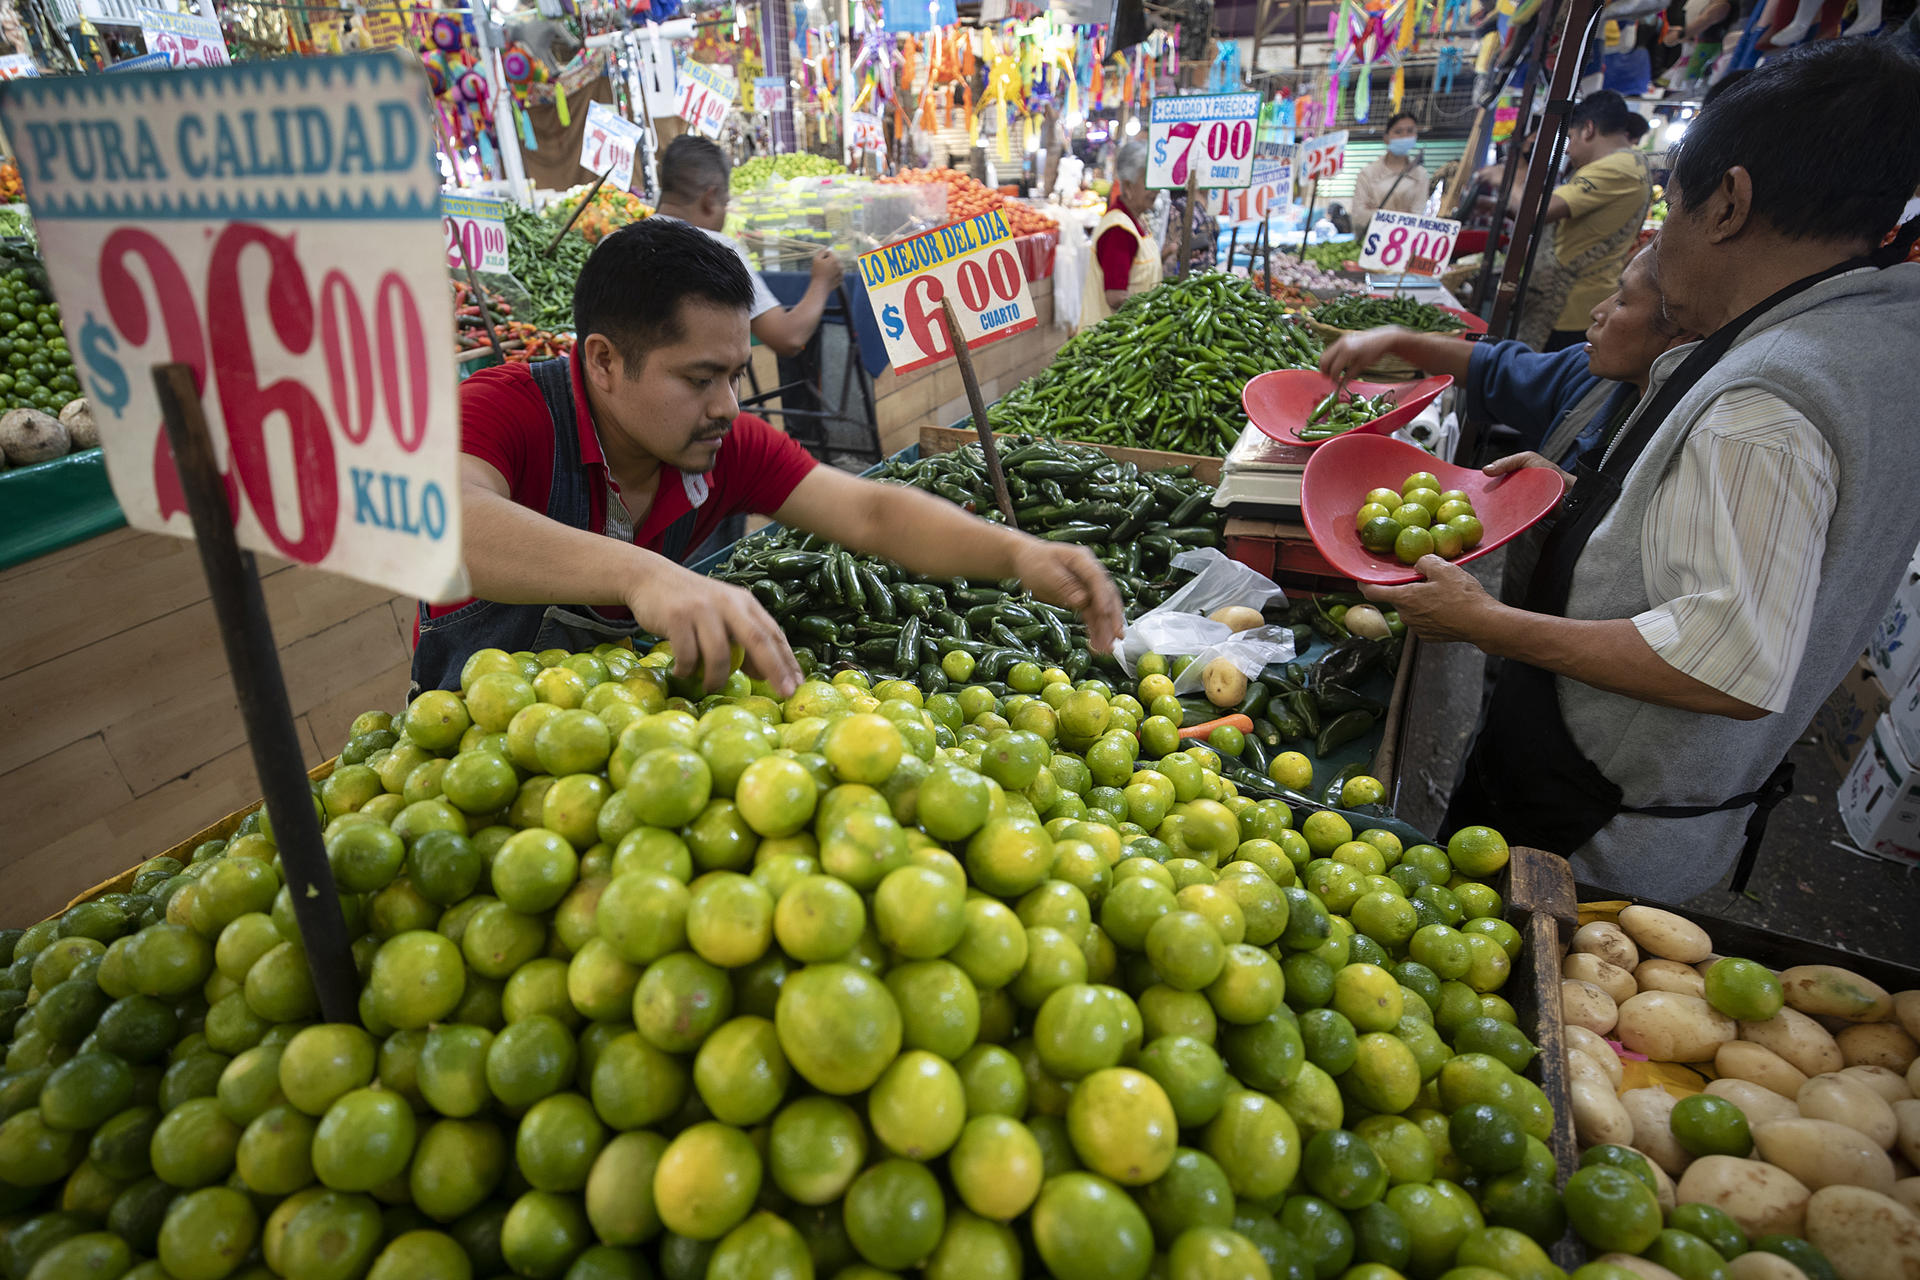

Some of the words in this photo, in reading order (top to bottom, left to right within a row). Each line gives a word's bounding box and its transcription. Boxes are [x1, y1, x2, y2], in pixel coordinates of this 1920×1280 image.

[1164, 101, 1201, 116] CALIDAD
[1205, 101, 1211, 115] Y
[1213, 99, 1248, 115] PRECIO
[26, 116, 168, 184] PURA
[176, 100, 419, 178] CALIDAD
[1210, 165, 1239, 179] CUARTO
[1375, 211, 1397, 224] MAS
[1398, 215, 1417, 227] POR
[1418, 218, 1451, 234] MENOS
[860, 257, 885, 287] LO
[884, 233, 943, 280] MEJOR
[940, 221, 977, 258] DEL
[974, 209, 1010, 246] DIA
[979, 302, 1021, 331] CUARTO
[351, 467, 447, 541] KILO
